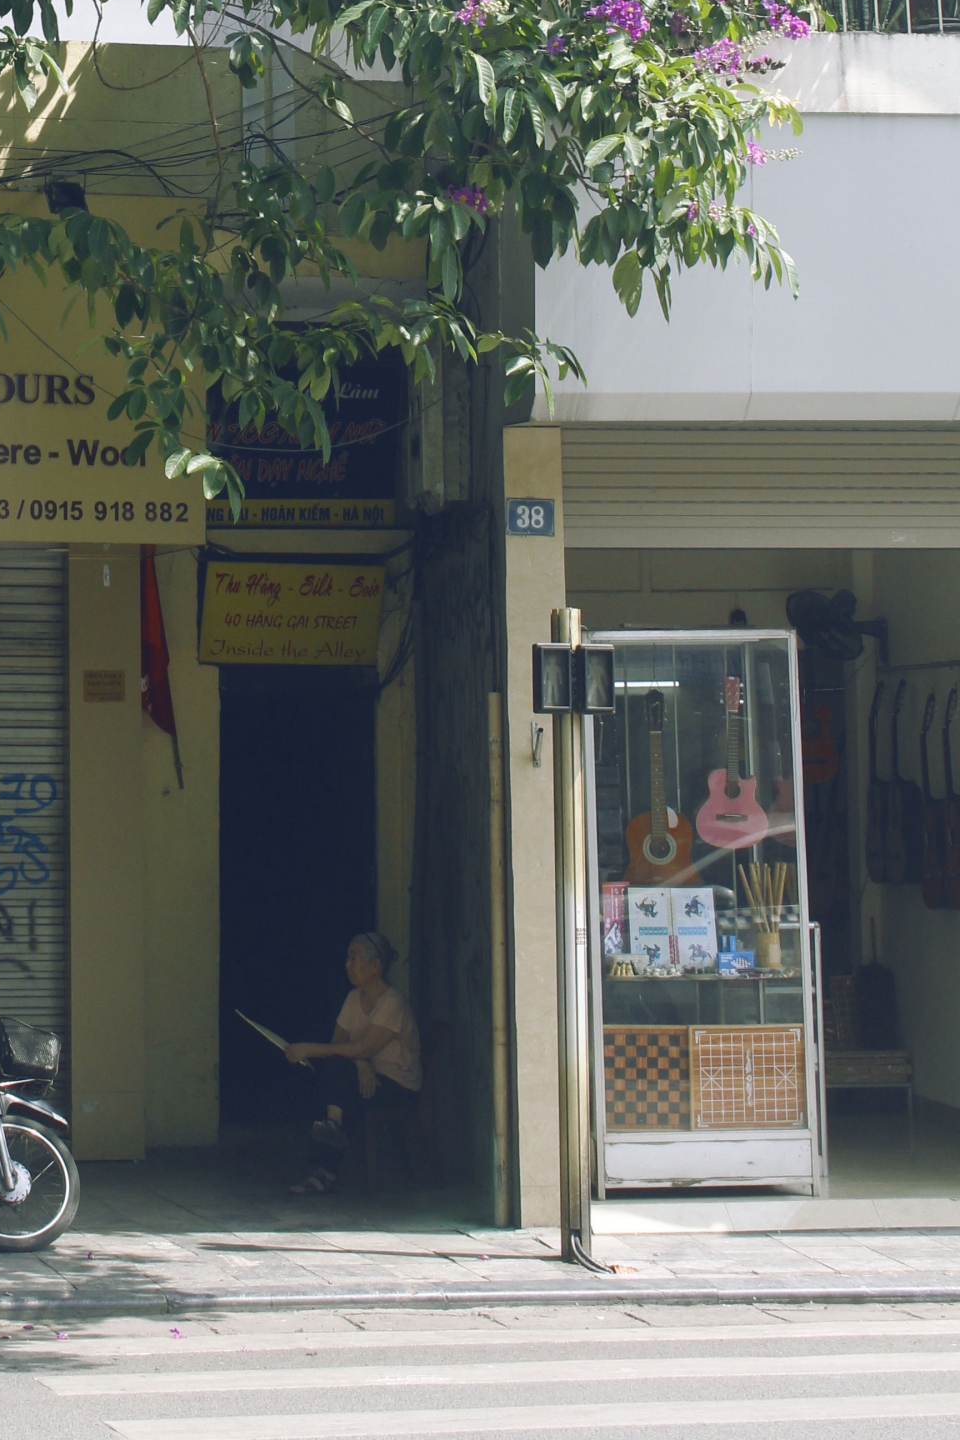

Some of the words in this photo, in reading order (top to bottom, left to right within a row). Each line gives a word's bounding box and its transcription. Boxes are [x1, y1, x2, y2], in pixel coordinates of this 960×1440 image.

[30, 499, 83, 521] 0915
[94, 501, 135, 521] 918
[145, 501, 189, 522] 882
[260, 504, 295, 522] HOÀN
[299, 502, 331, 522] KIẾM
[343, 504, 359, 522] HÀ
[363, 504, 384, 525] NỘI
[516, 505, 544, 529] 38
[215, 570, 241, 594] Thu
[299, 573, 334, 597] Silk
[224, 612, 241, 628] 40
[246, 610, 283, 630] HÀNG
[286, 614, 310, 630] GAI
[313, 615, 358, 631] STREET
[210, 638, 275, 657] Inside
[282, 640, 309, 659] the
[314, 641, 367, 662] Alley
